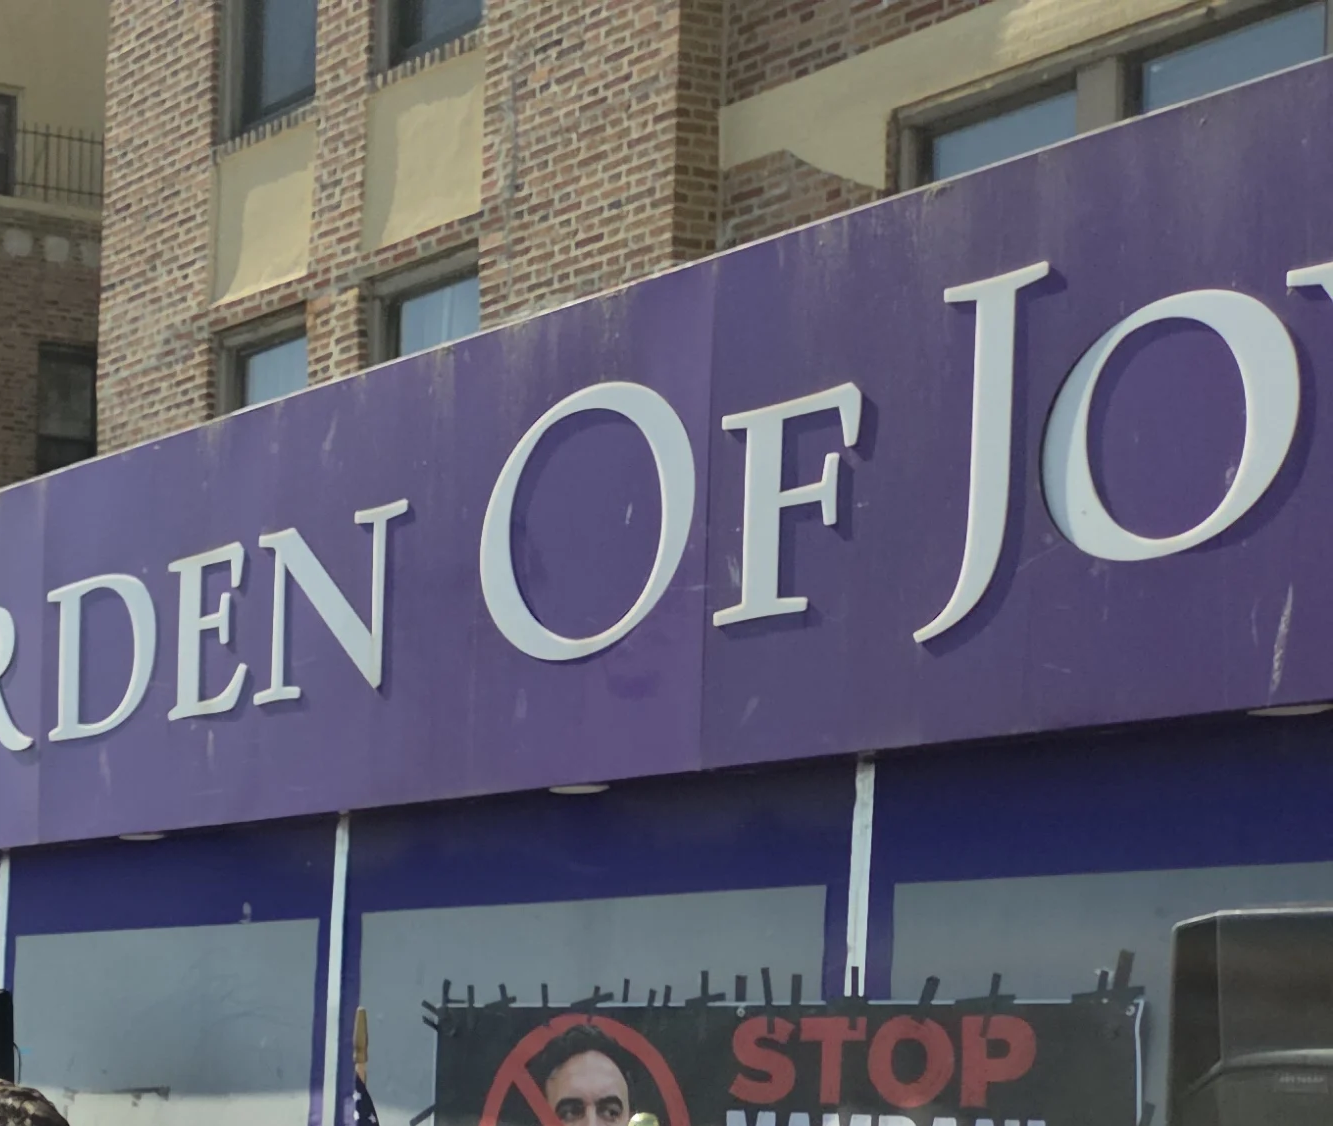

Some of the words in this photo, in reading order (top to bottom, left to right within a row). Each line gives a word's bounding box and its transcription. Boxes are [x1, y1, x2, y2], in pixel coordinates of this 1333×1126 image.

[479, 381, 862, 661] OF
[913, 261, 1333, 643] JO
[727, 1013, 1038, 1110] STOP
